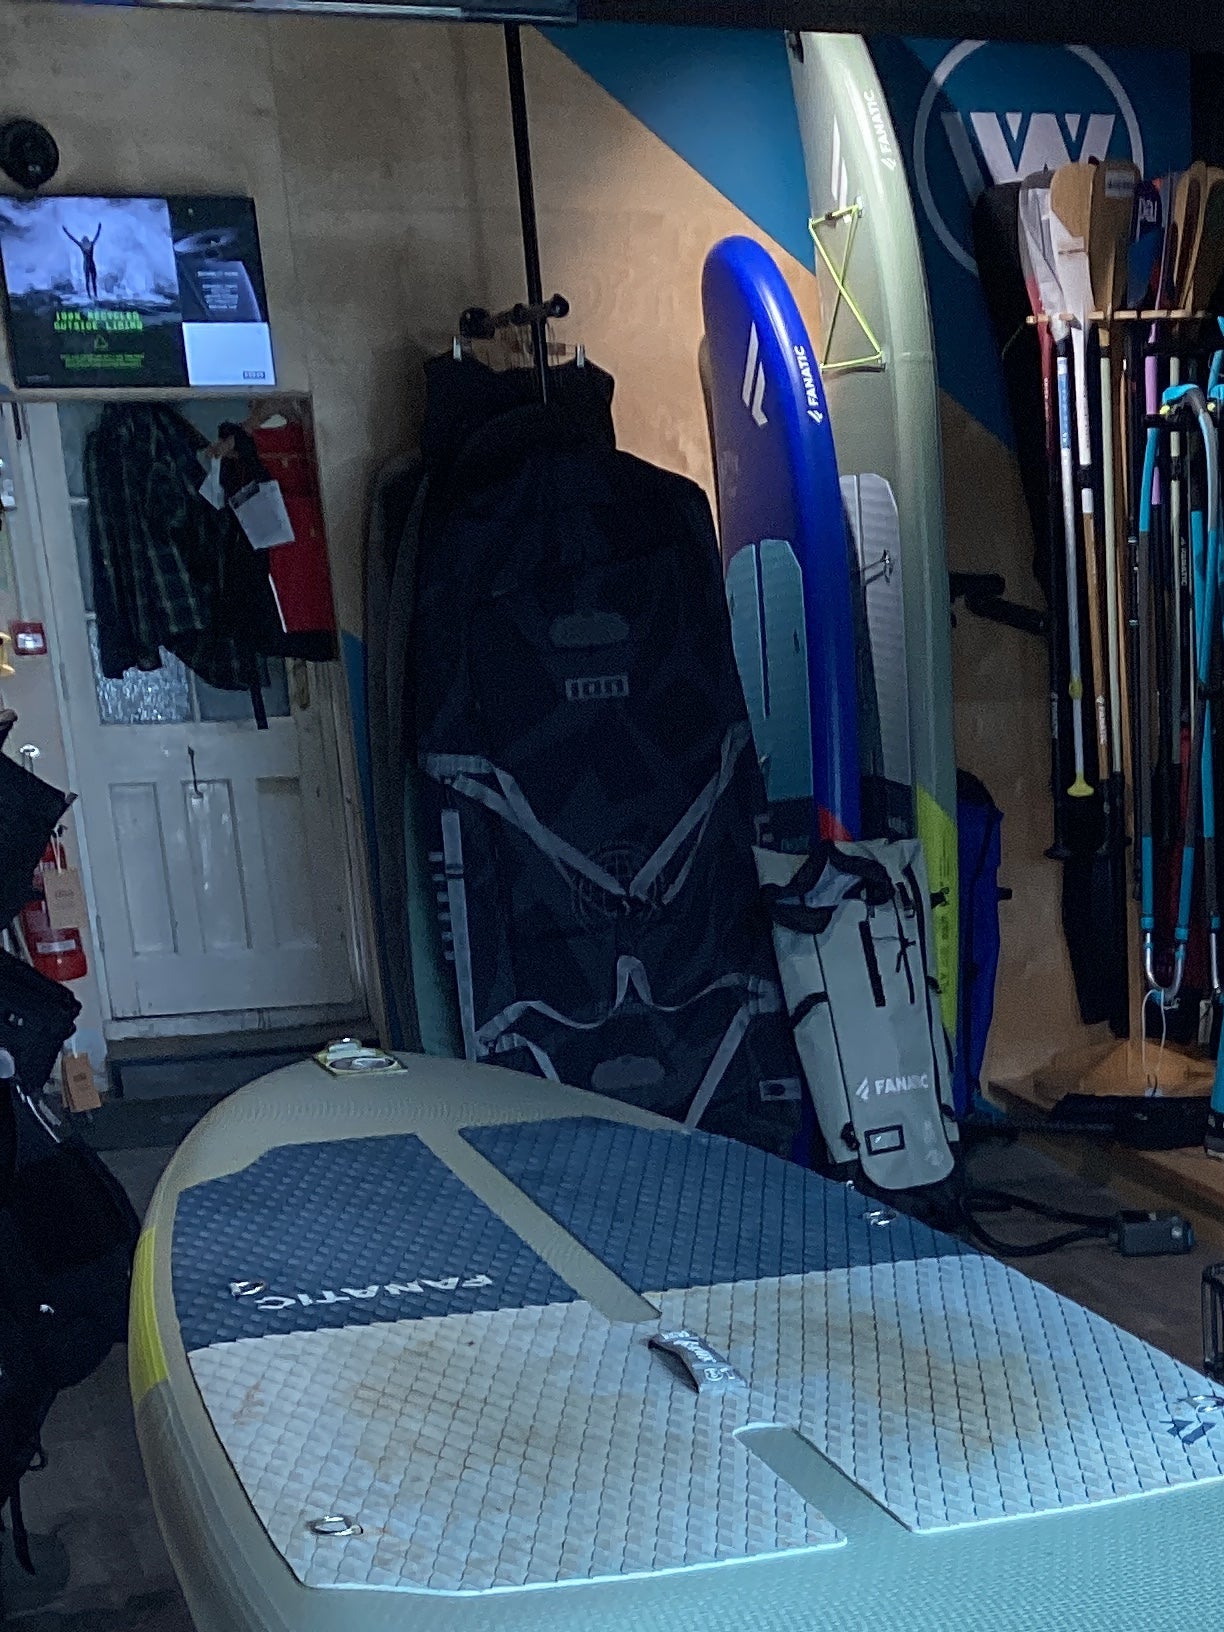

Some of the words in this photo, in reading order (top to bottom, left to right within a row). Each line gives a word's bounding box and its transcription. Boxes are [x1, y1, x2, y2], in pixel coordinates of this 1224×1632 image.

[863, 89, 892, 153] FANATIC
[793, 345, 818, 406] FANATIC
[254, 1274, 494, 1311] FANATIC
